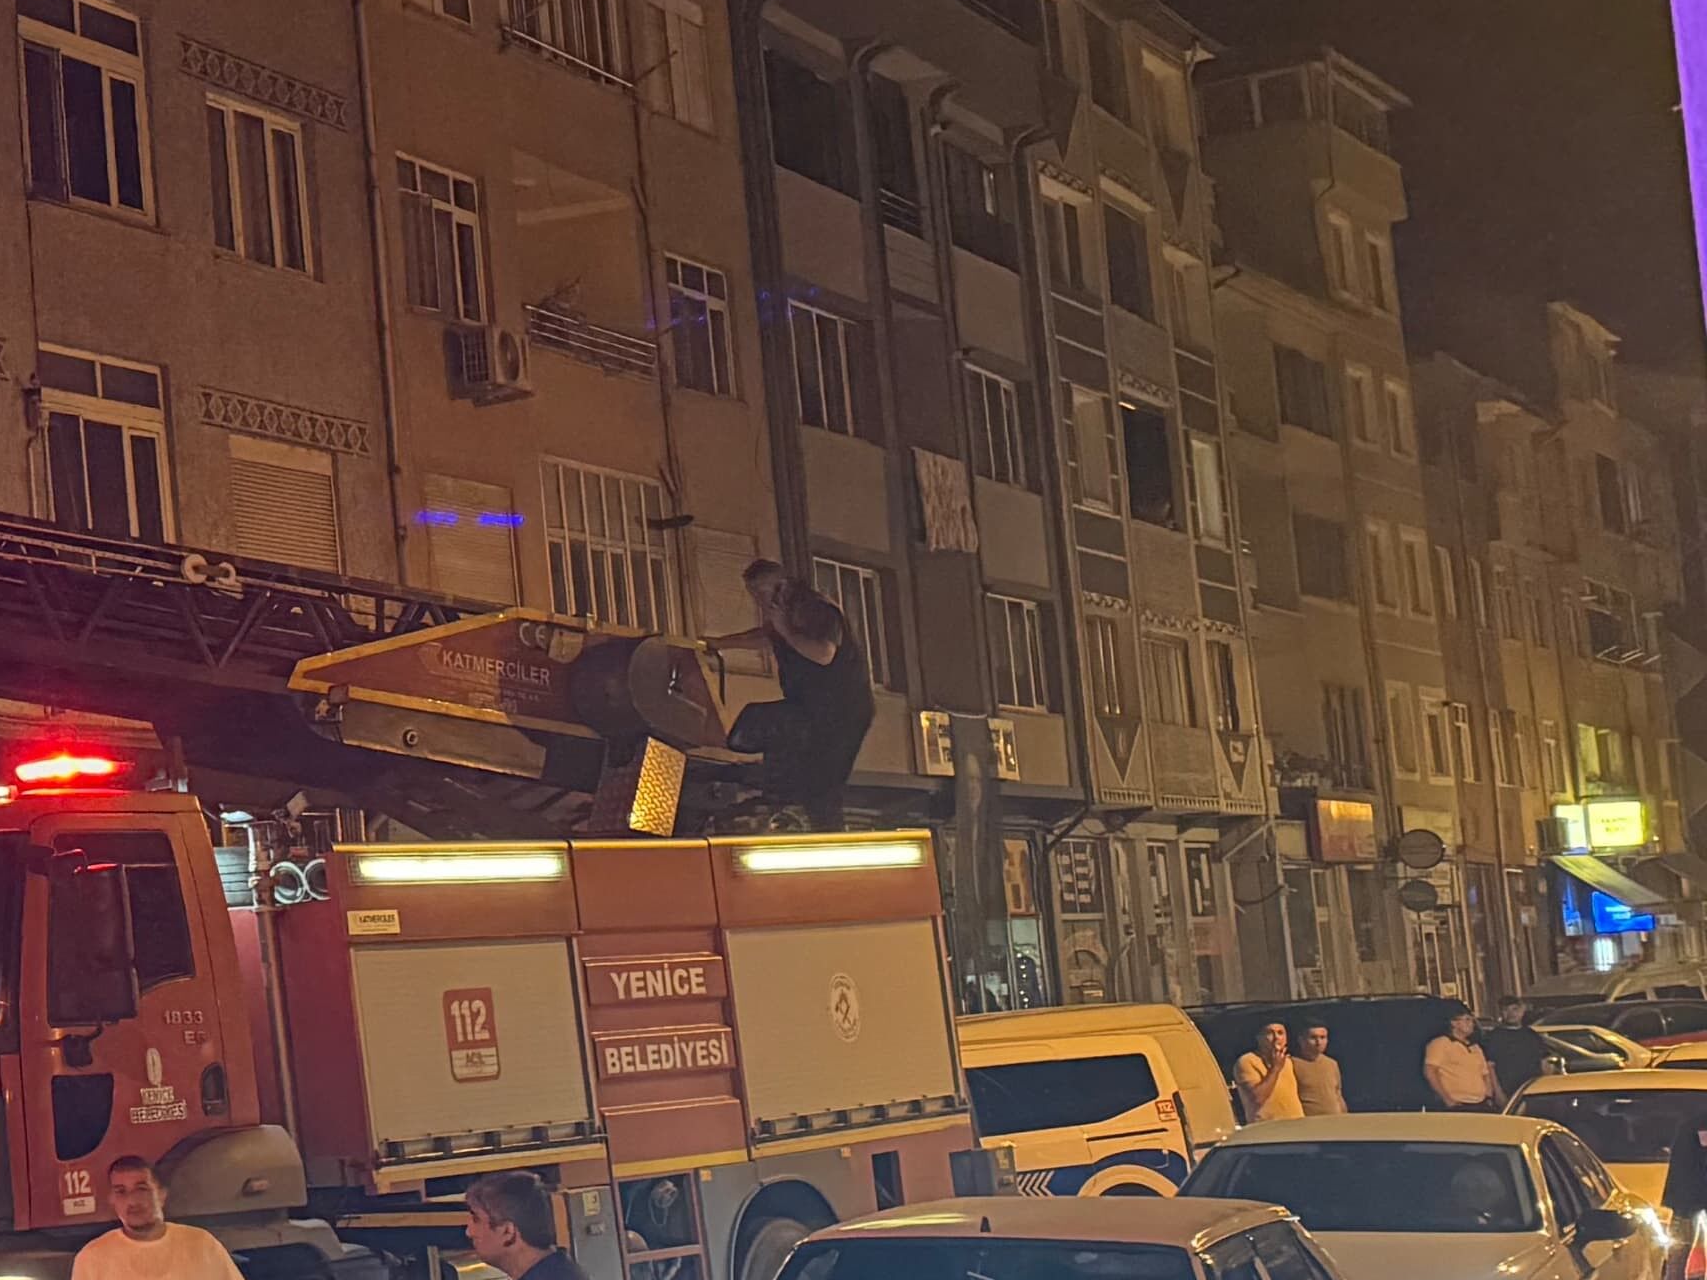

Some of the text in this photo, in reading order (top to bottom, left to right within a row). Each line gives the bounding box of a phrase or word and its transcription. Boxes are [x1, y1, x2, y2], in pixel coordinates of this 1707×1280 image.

[443, 650, 550, 686] KATMERCİLER
[611, 963, 706, 1000] YENİCE
[164, 1010, 203, 1024] 1833
[451, 1000, 489, 1042] 112
[605, 1032, 728, 1074] BELEDİYESİ
[64, 1170, 92, 1195] 112
